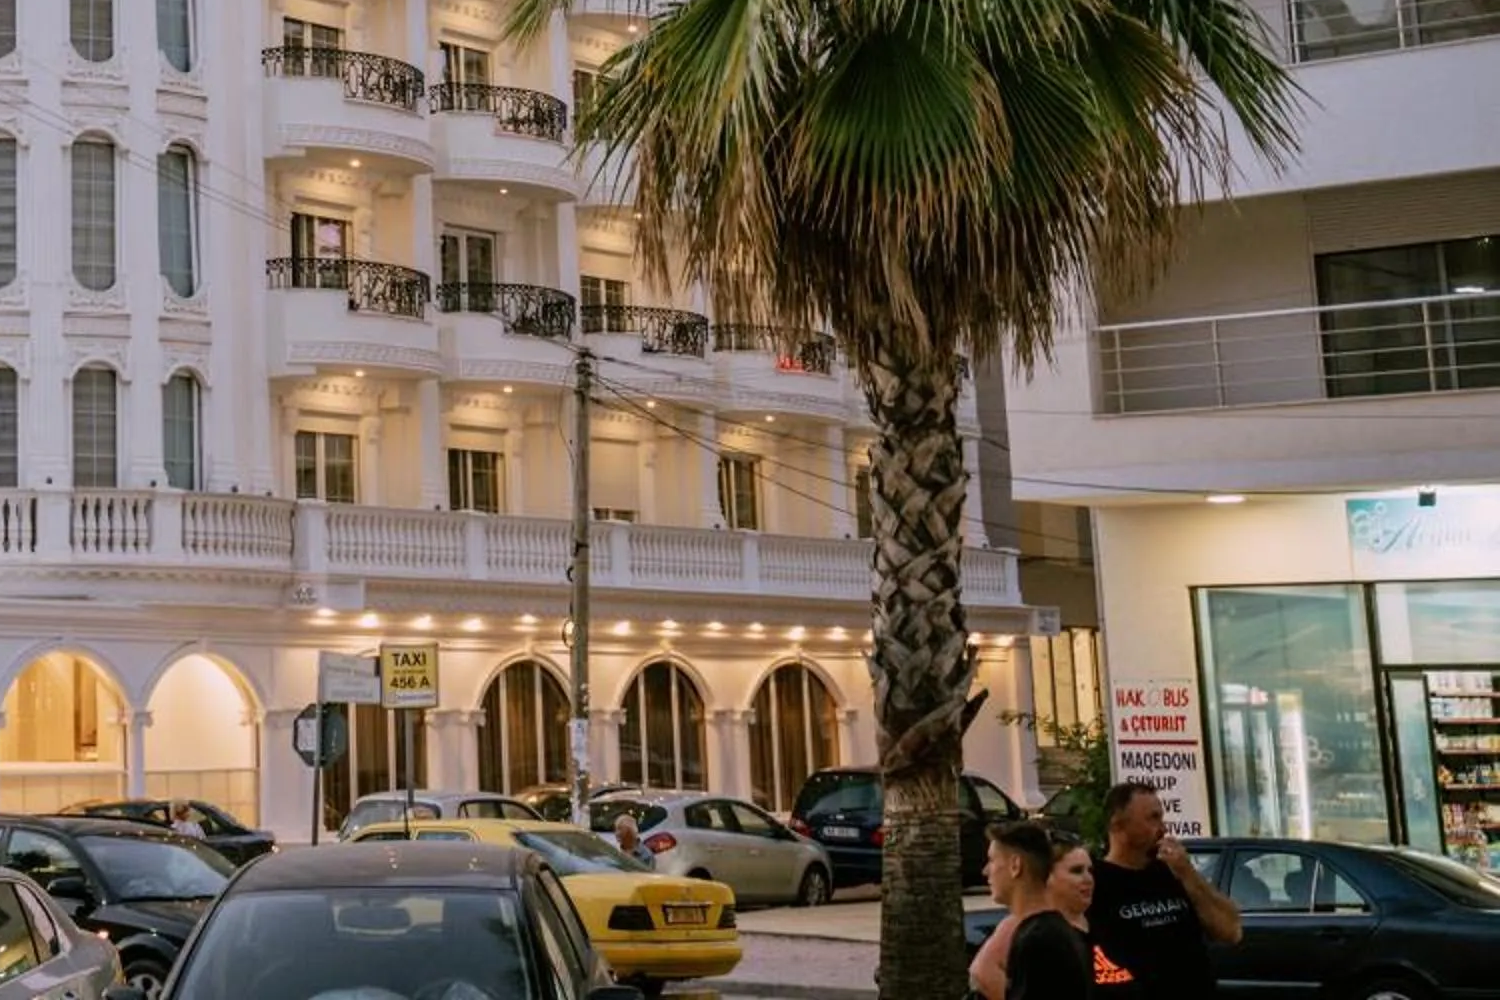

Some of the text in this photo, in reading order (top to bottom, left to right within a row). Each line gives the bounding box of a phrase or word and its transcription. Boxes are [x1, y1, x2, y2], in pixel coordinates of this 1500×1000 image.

[392, 651, 427, 667] TAXI
[420, 676, 431, 689] A
[1115, 687, 1190, 707] HAK BUS
[1121, 752, 1197, 772] MAQEDONI
